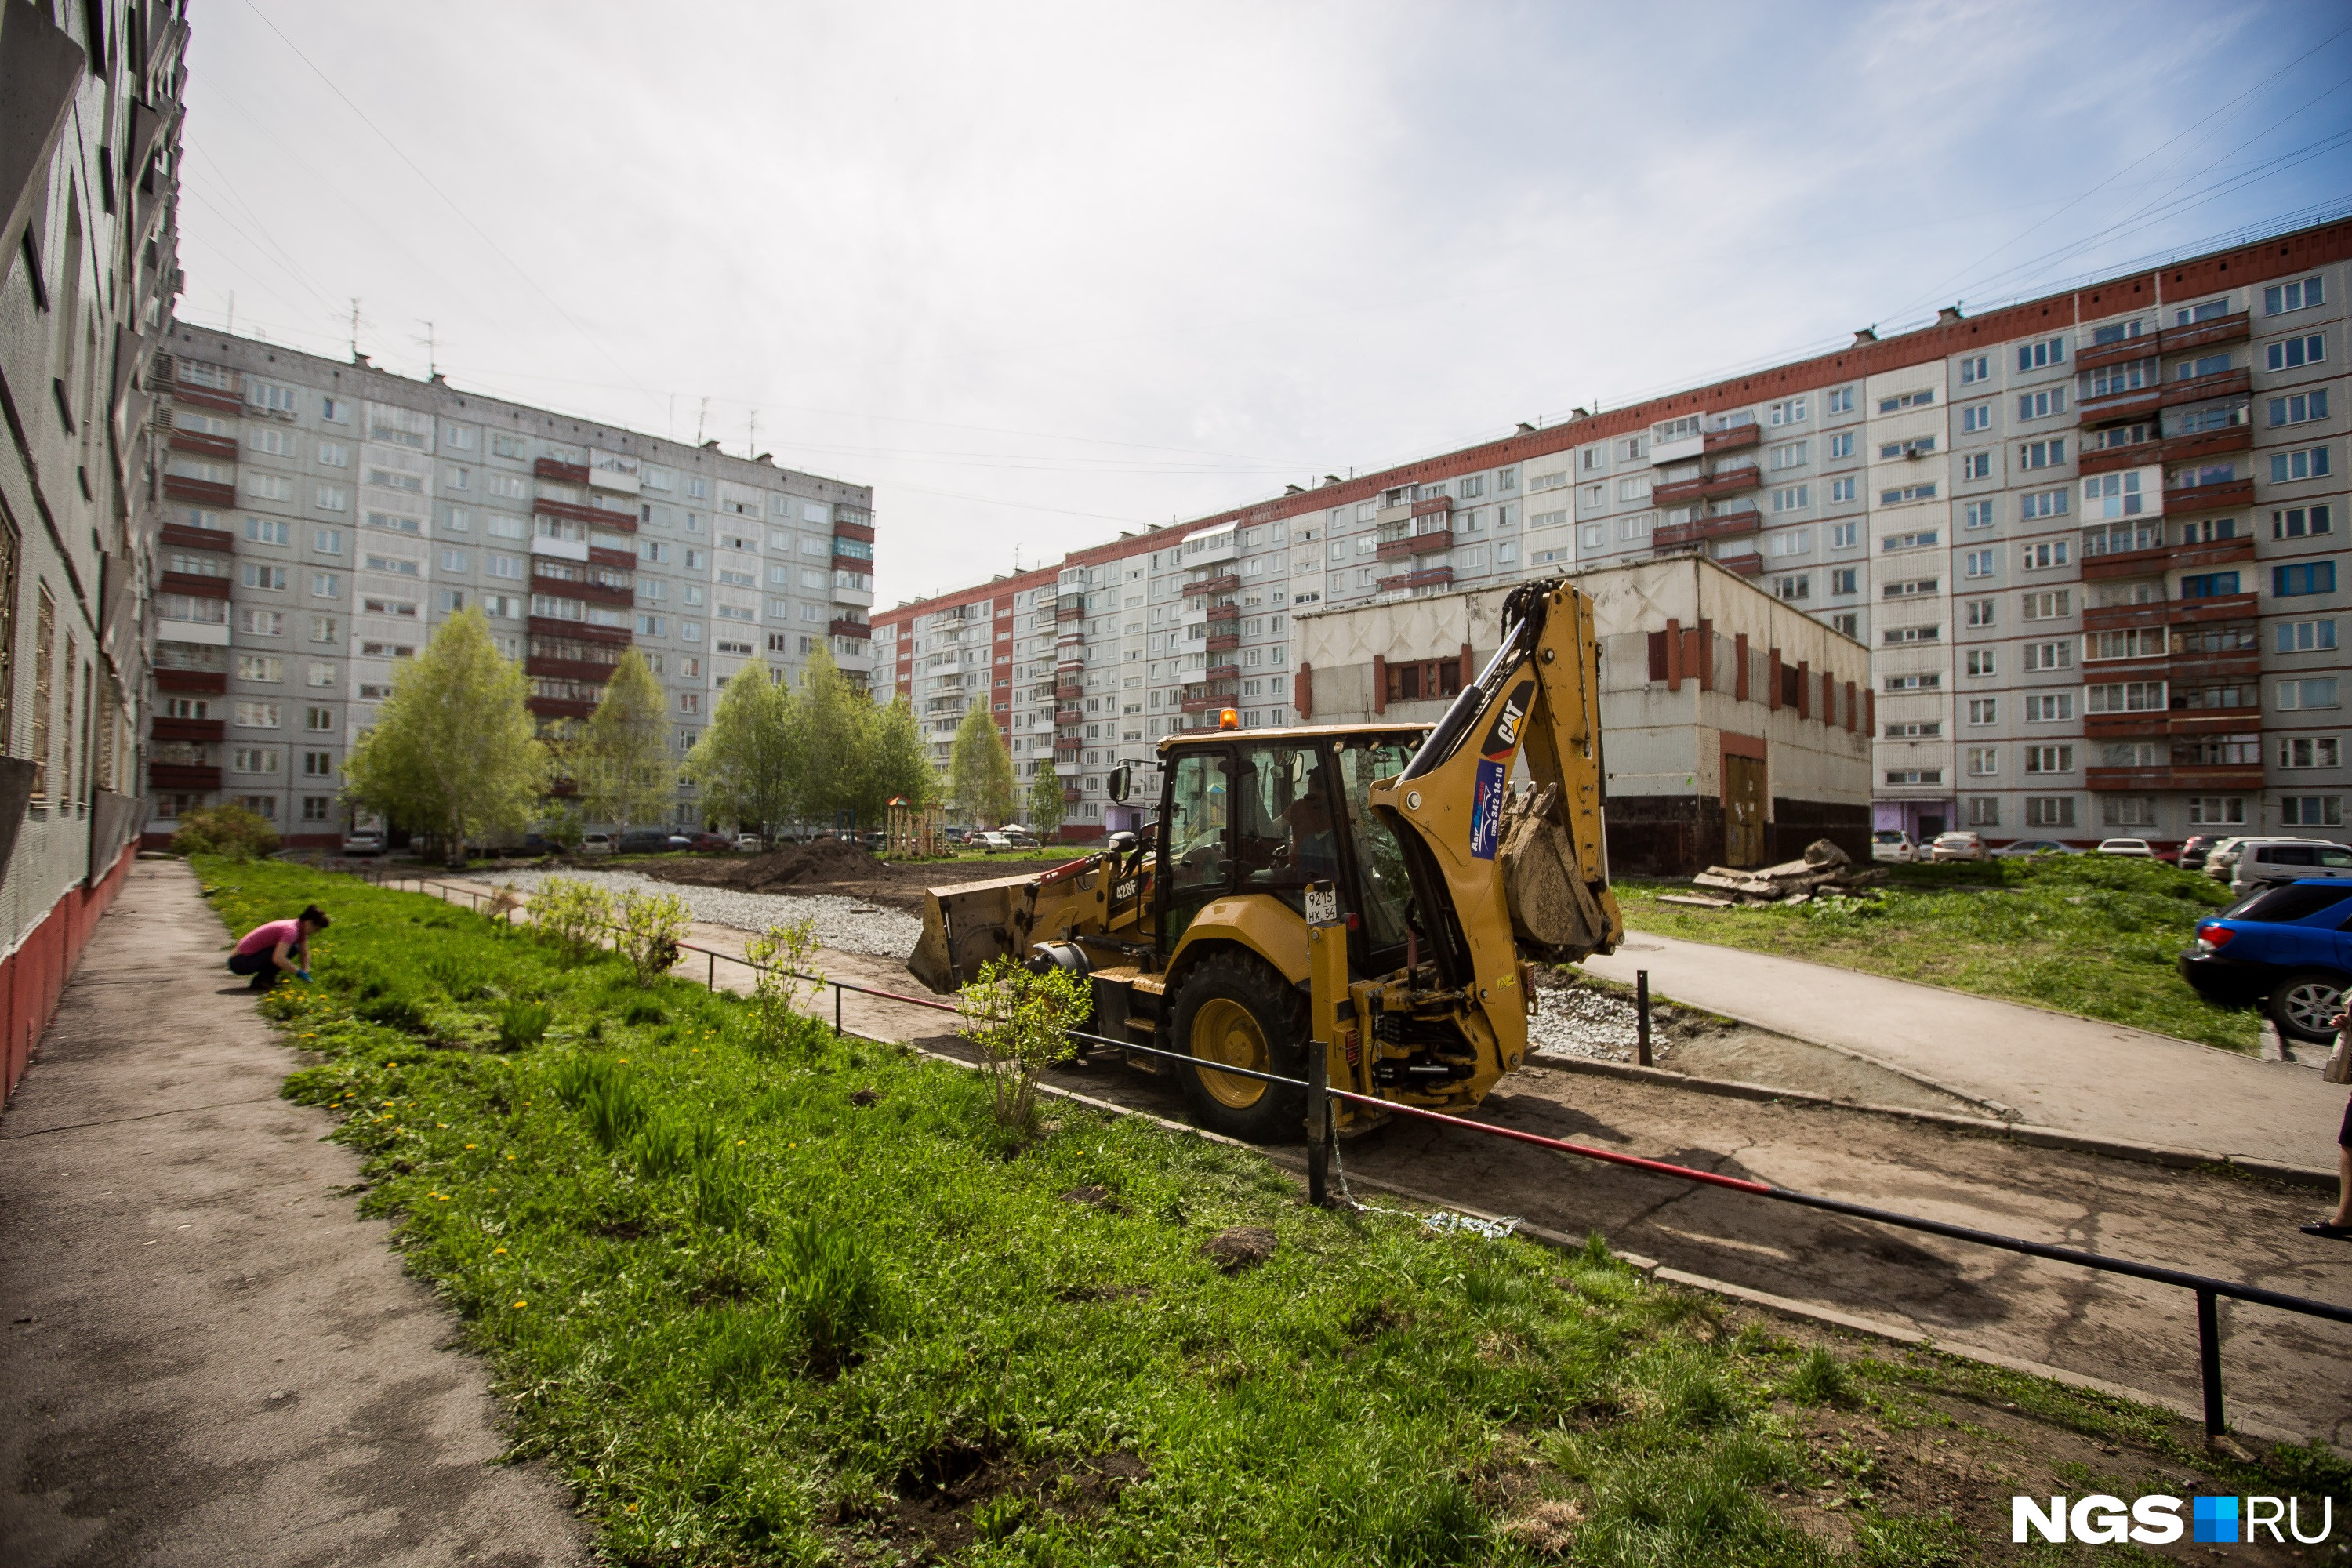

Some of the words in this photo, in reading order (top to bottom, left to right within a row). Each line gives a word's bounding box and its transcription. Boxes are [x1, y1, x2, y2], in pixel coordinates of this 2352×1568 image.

[1498, 699, 1523, 744] CAT
[1491, 767, 1503, 818] 342-14-10
[1116, 880, 1136, 899] 428F
[1309, 891, 1333, 907] 9215
[1325, 907, 1334, 918] 54
